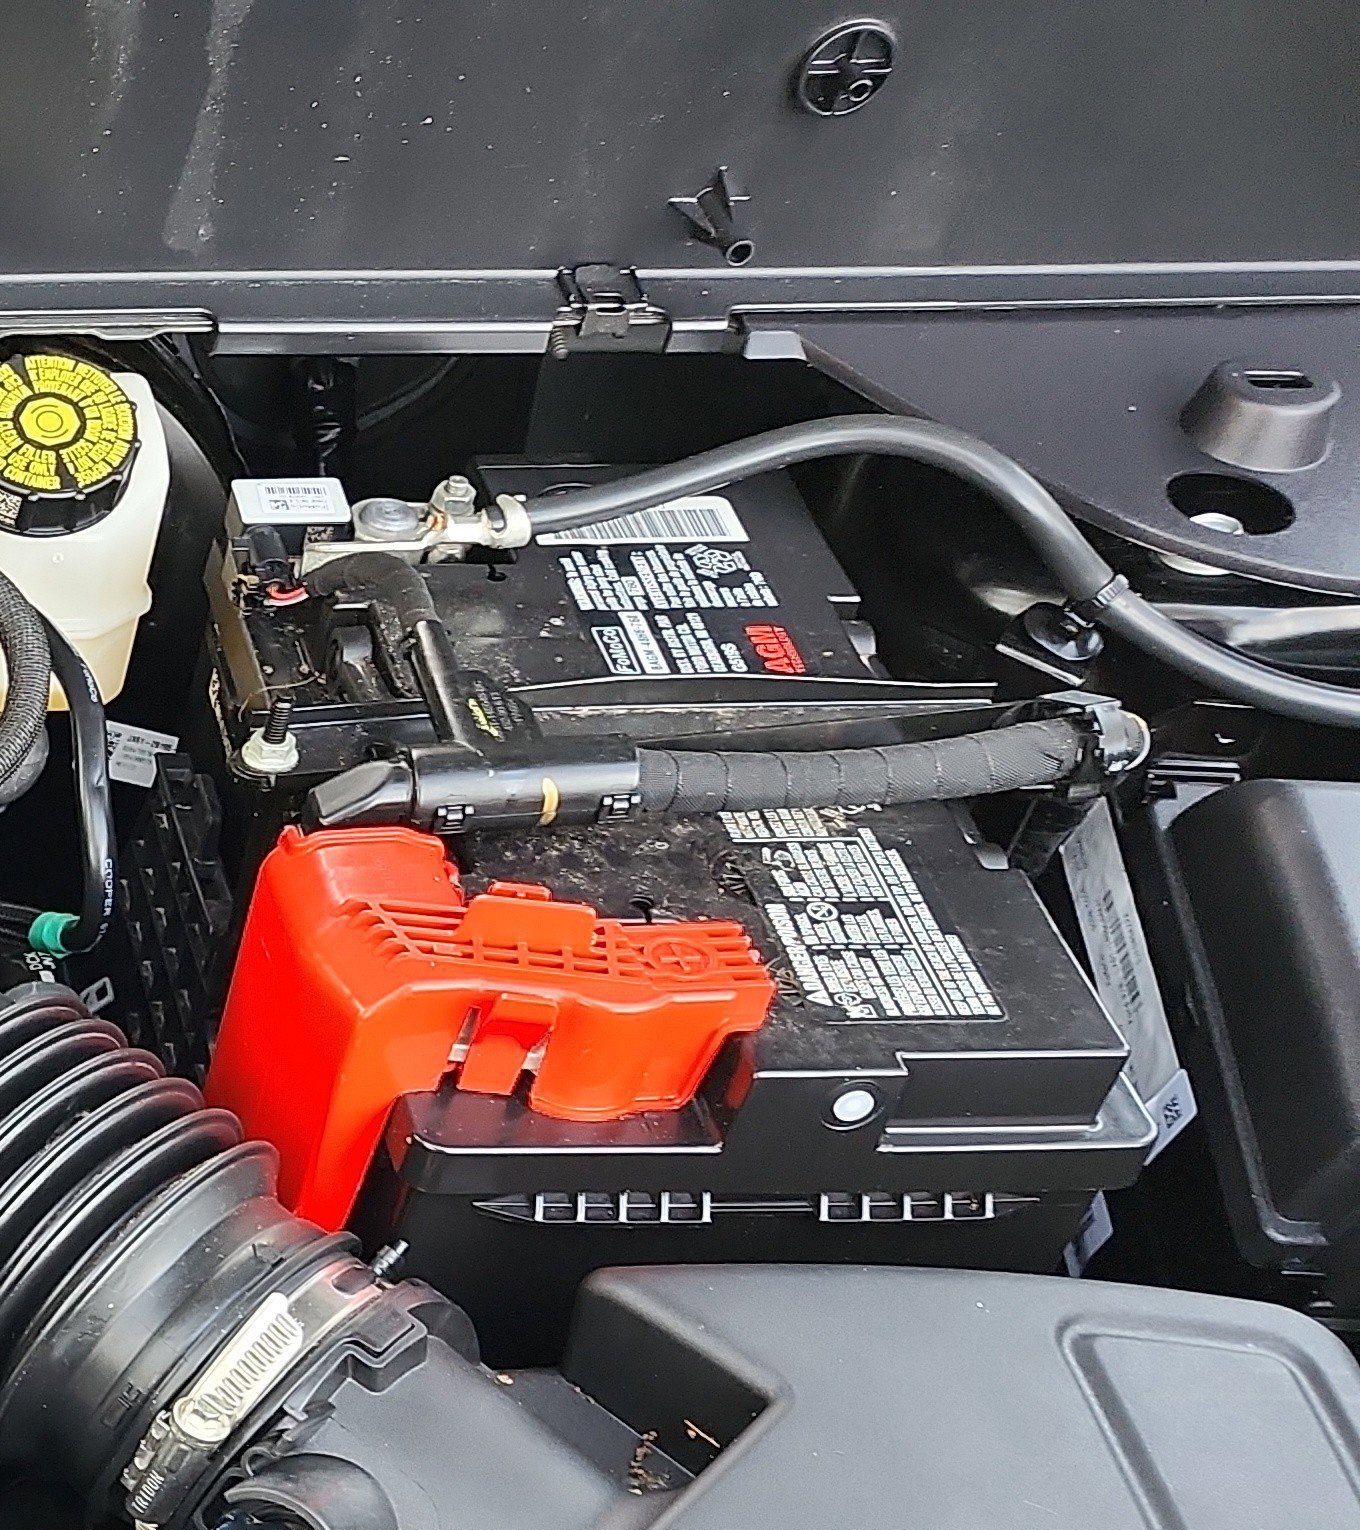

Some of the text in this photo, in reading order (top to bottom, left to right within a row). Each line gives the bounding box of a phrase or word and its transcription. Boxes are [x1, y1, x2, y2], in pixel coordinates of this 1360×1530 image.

[25, 355, 76, 370] ATTENTION
[8, 452, 29, 467] USE
[29, 462, 56, 476] ONLY
[18, 444, 56, 462] FILLER
[3, 466, 61, 489] CONTAINER
[599, 629, 635, 671] FoMoCo
[743, 625, 794, 672] AGM
[762, 903, 829, 990] DANGER/POISON
[129, 1469, 166, 1514] TRIDON
